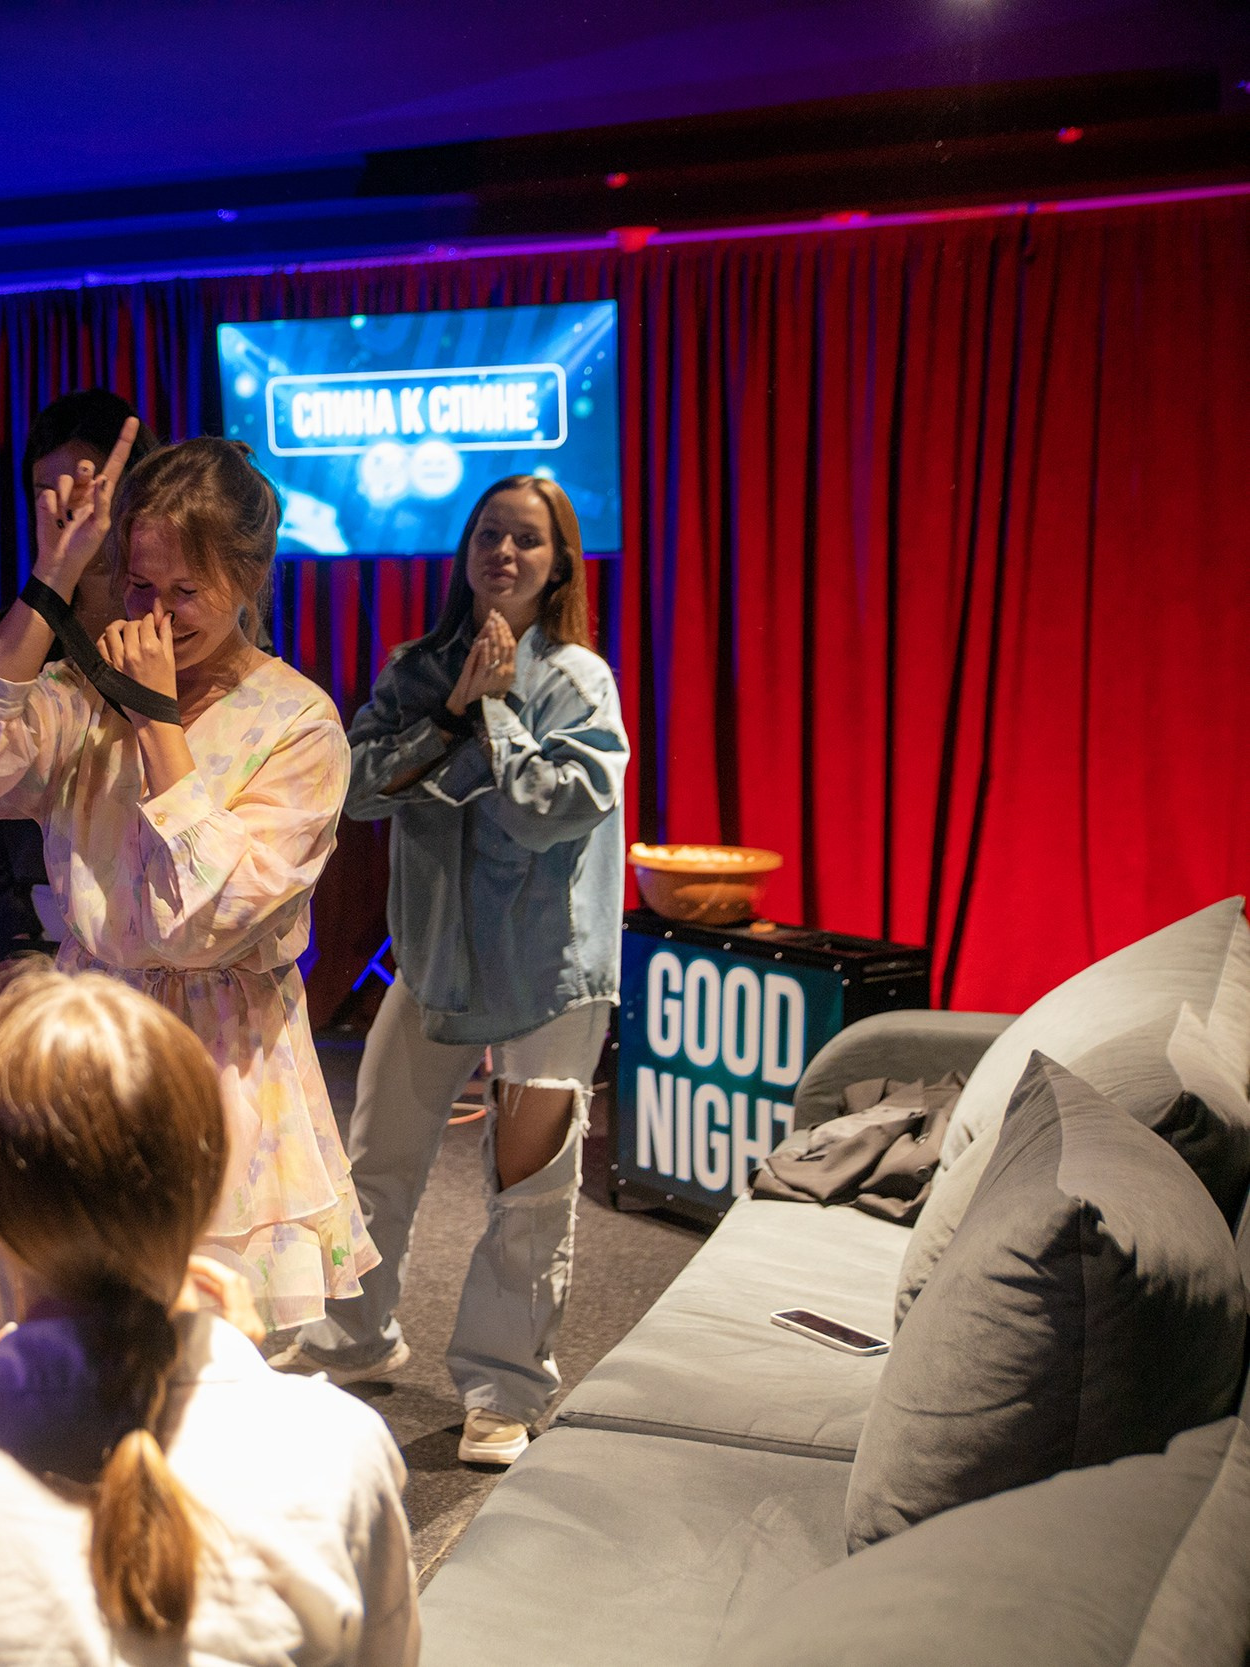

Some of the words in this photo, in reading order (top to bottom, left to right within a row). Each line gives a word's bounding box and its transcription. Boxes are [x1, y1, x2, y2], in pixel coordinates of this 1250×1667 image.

[291, 388, 397, 438] СПИНА
[401, 387, 425, 434] К
[428, 382, 538, 432] СПИНЕ
[646, 951, 805, 1087] GOOD
